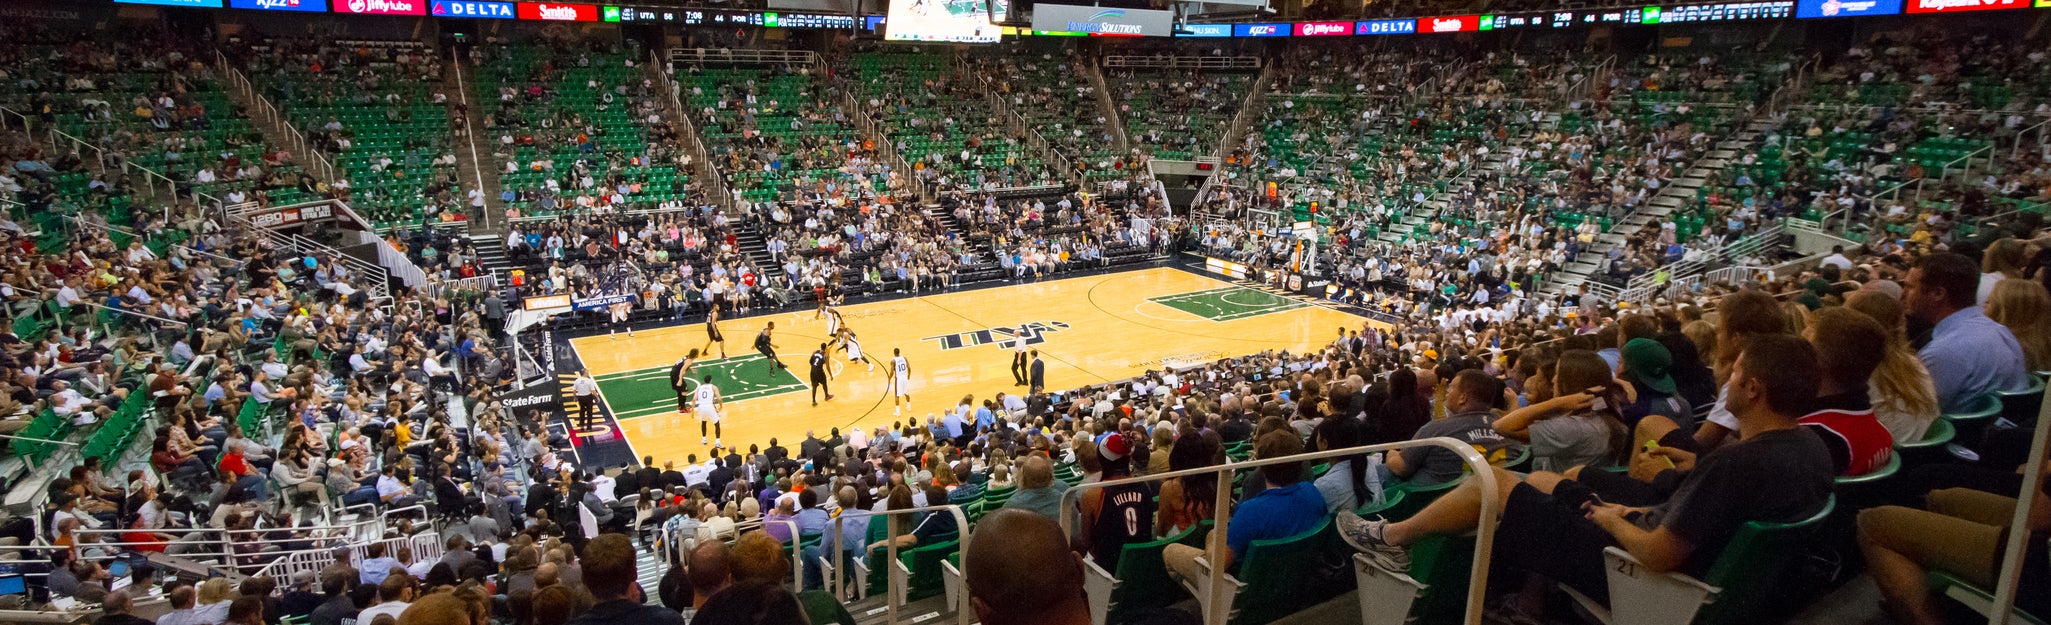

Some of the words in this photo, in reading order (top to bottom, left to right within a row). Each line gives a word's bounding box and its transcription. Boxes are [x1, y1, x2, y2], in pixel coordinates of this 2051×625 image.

[451, 3, 511, 16] DELTA
[640, 12, 655, 20] UTA
[732, 15, 747, 23] POR
[1602, 13, 1620, 21] POR
[1371, 22, 1413, 32] DELTA
[251, 212, 283, 226] 1280
[577, 299, 608, 308] AMERICA
[608, 296, 628, 304] FIRST
[897, 363, 907, 372] 10
[702, 391, 708, 399] 0
[1113, 491, 1142, 506] LILLARD
[1125, 506, 1137, 536] 0
[1617, 559, 1634, 577] 21
